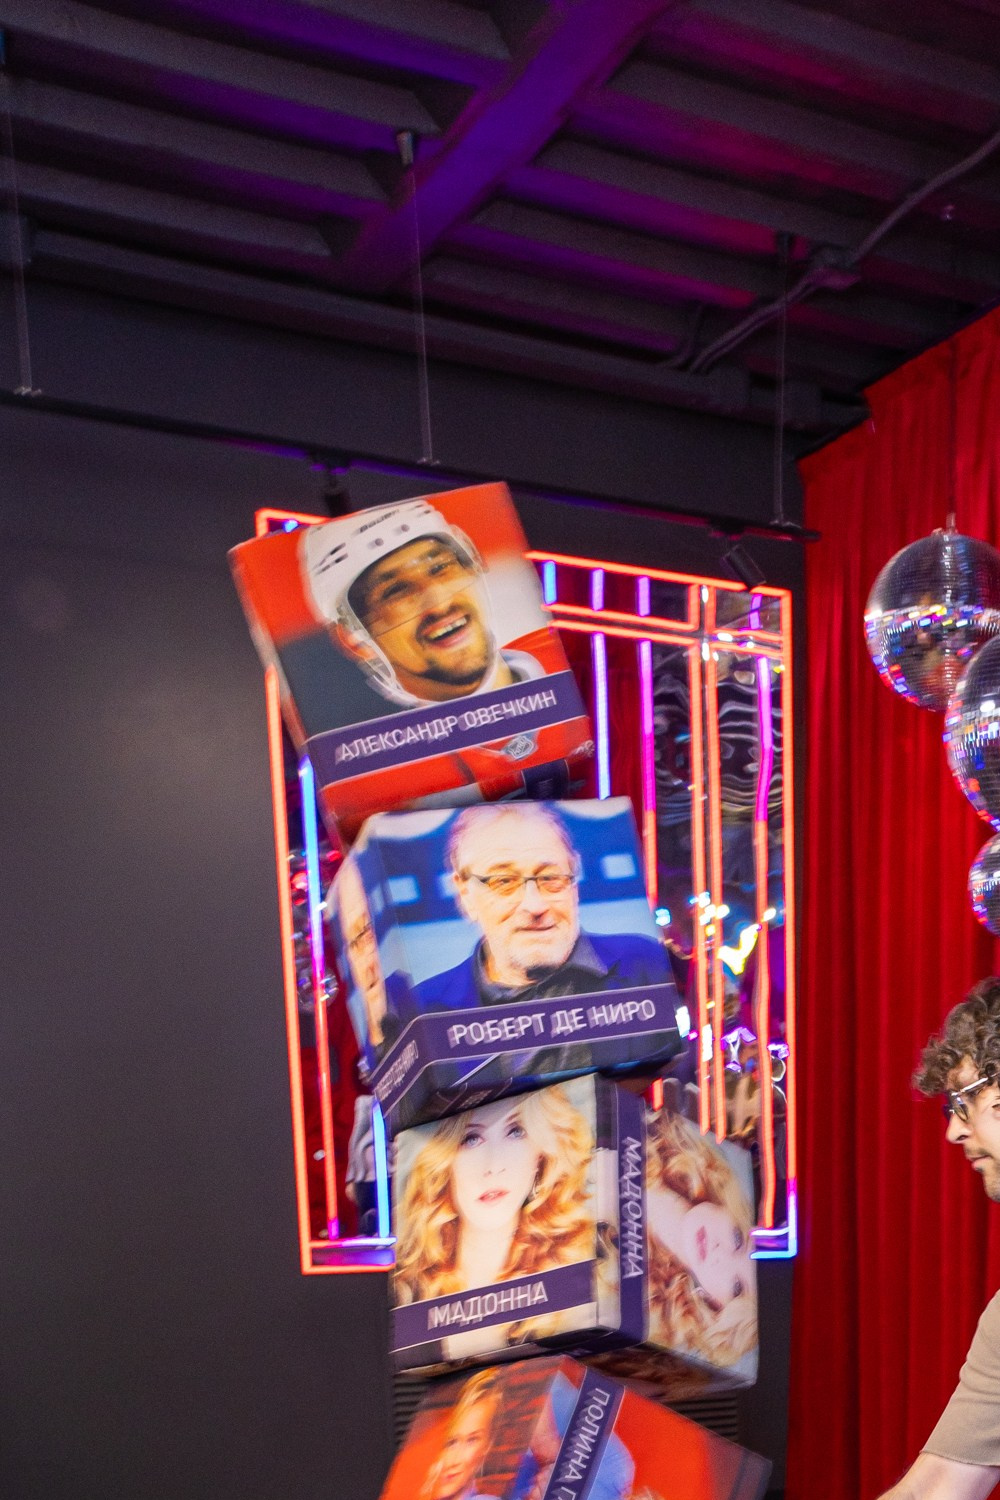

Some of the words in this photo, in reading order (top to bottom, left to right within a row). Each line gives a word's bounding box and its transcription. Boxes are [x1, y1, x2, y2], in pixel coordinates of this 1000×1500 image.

[337, 714, 459, 763] АЛЕКСАНДР
[461, 689, 558, 731] ОВЕЧКИН
[449, 1012, 546, 1047] РОБЕРТ
[552, 1007, 588, 1038] ДЕ
[588, 999, 657, 1028] НИРО
[621, 1136, 644, 1279] МАДОННА
[429, 1281, 549, 1329] МАДОННА
[559, 1387, 611, 1483] ПОЛИНА
